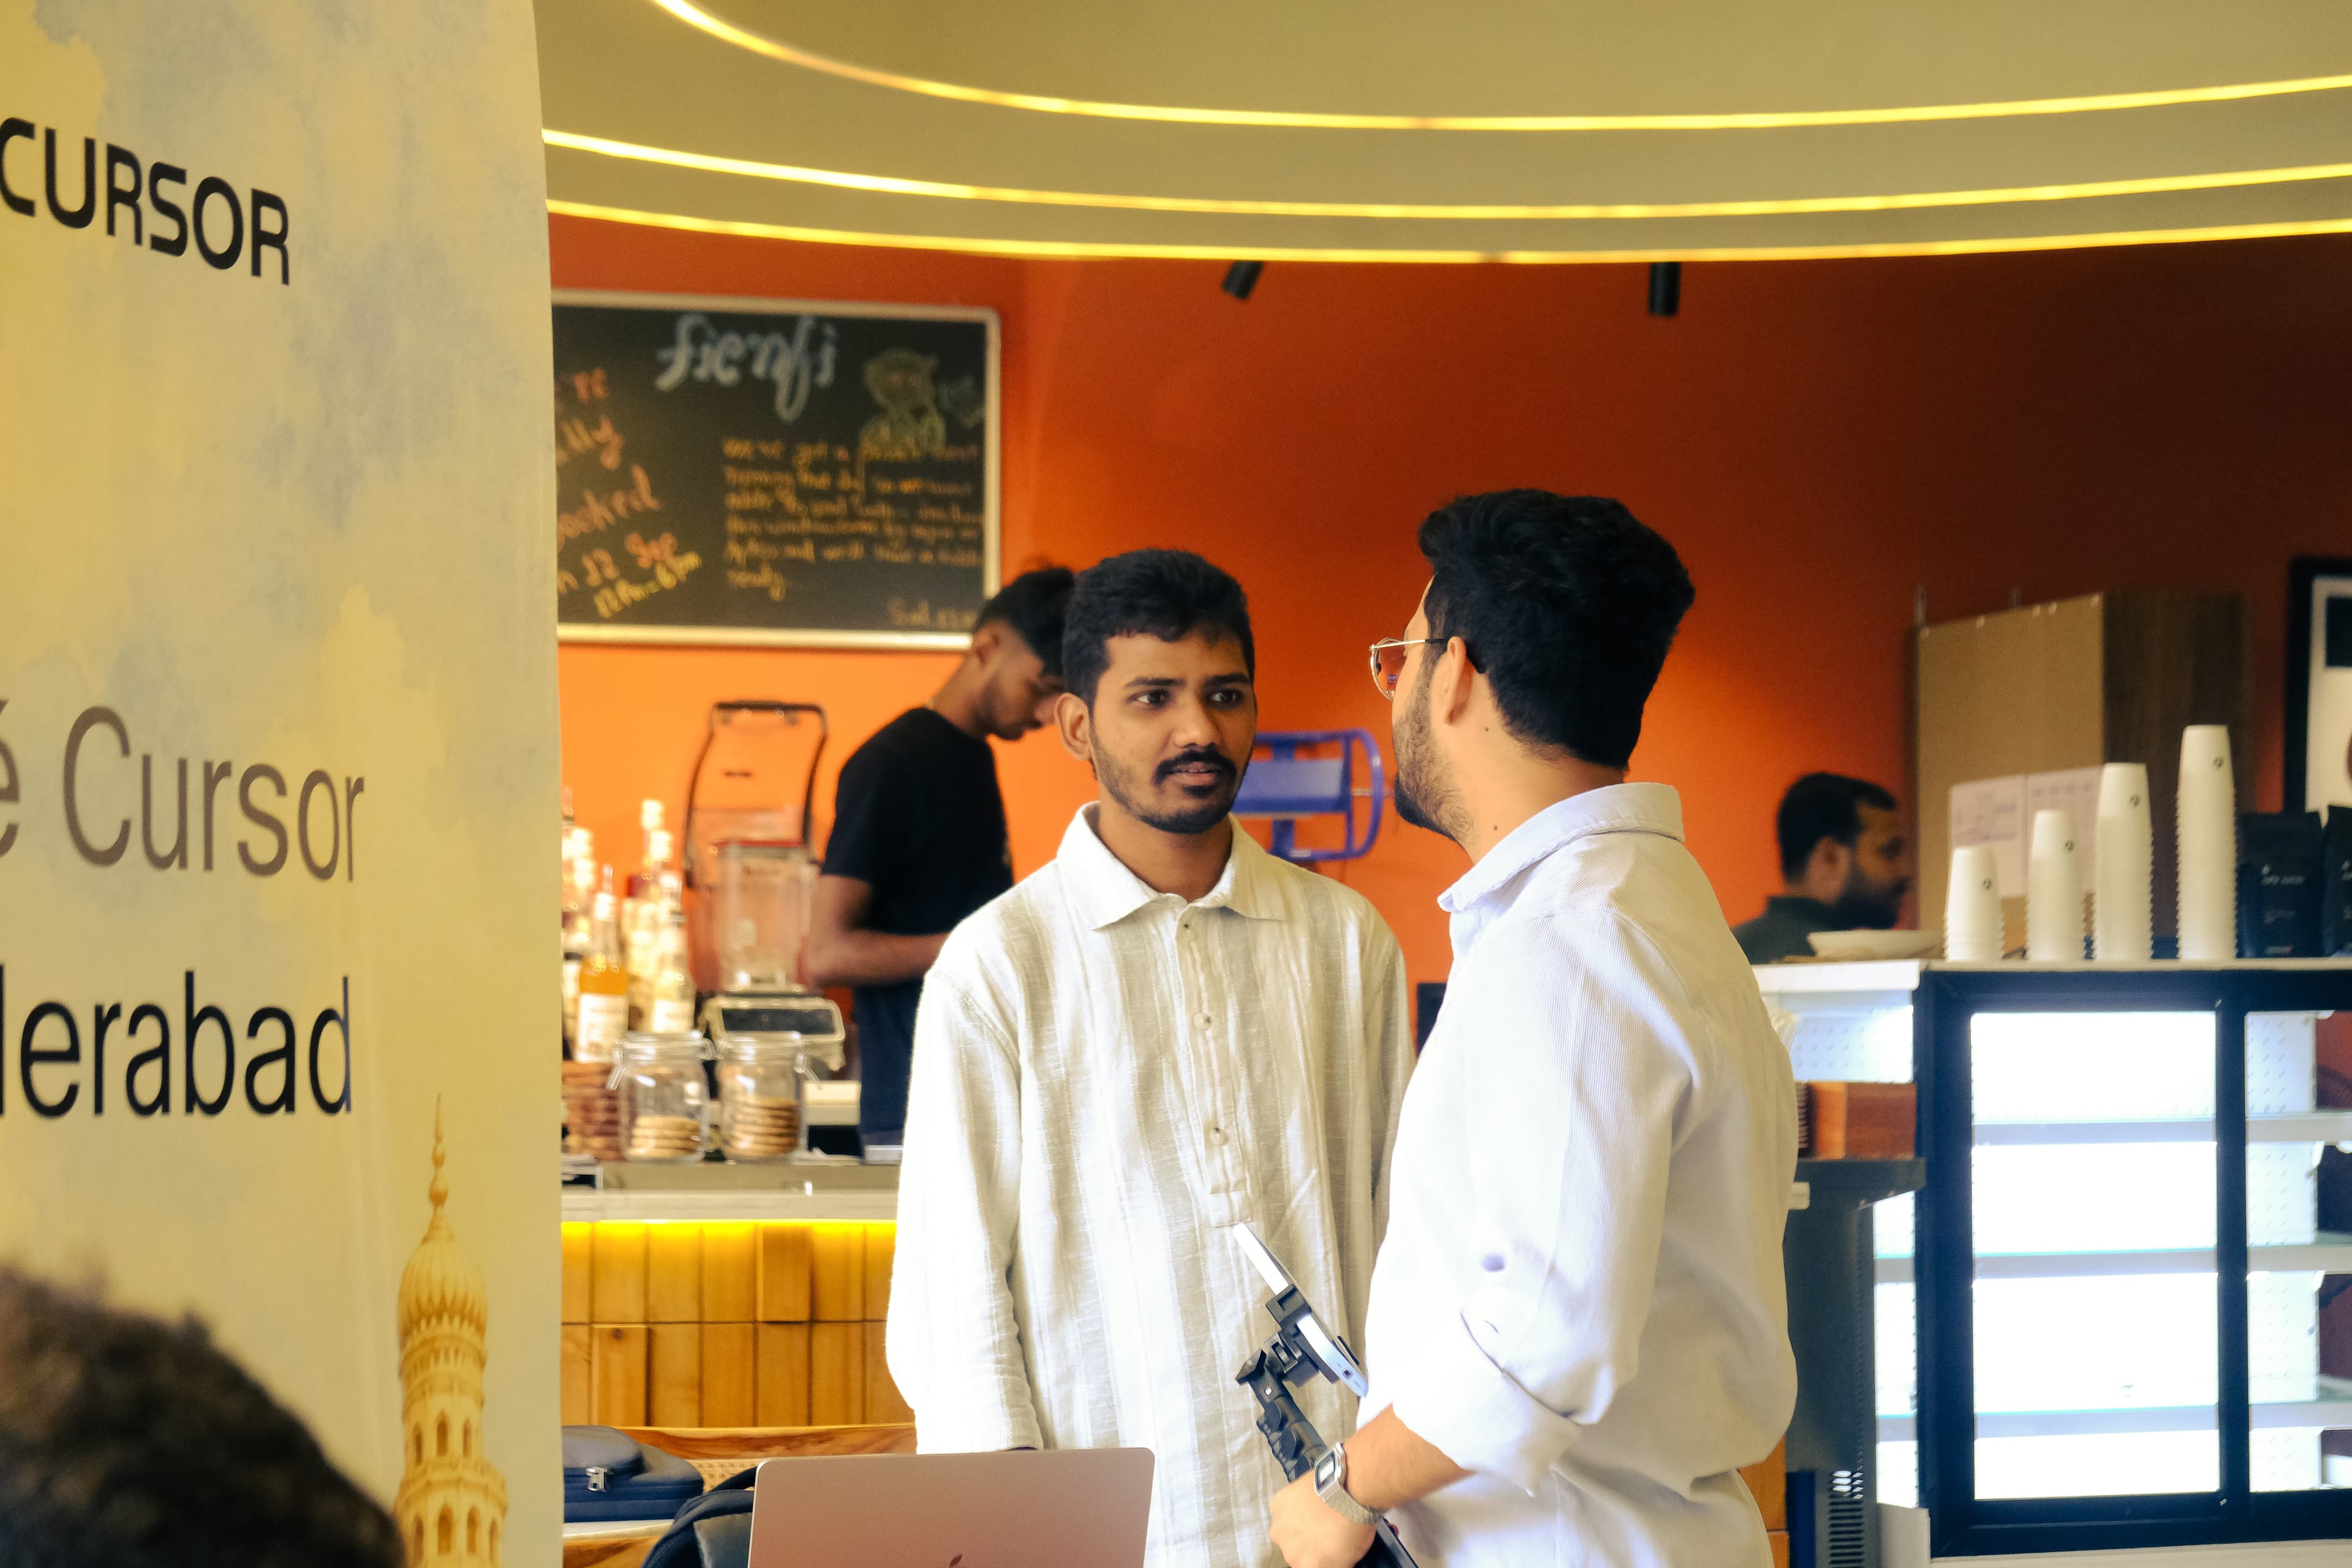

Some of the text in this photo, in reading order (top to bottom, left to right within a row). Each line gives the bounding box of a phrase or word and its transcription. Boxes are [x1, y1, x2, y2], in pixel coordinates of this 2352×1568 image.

[0, 116, 290, 285] CURSOR
[63, 705, 364, 882] Cursor
[0, 963, 352, 1120] erabad
